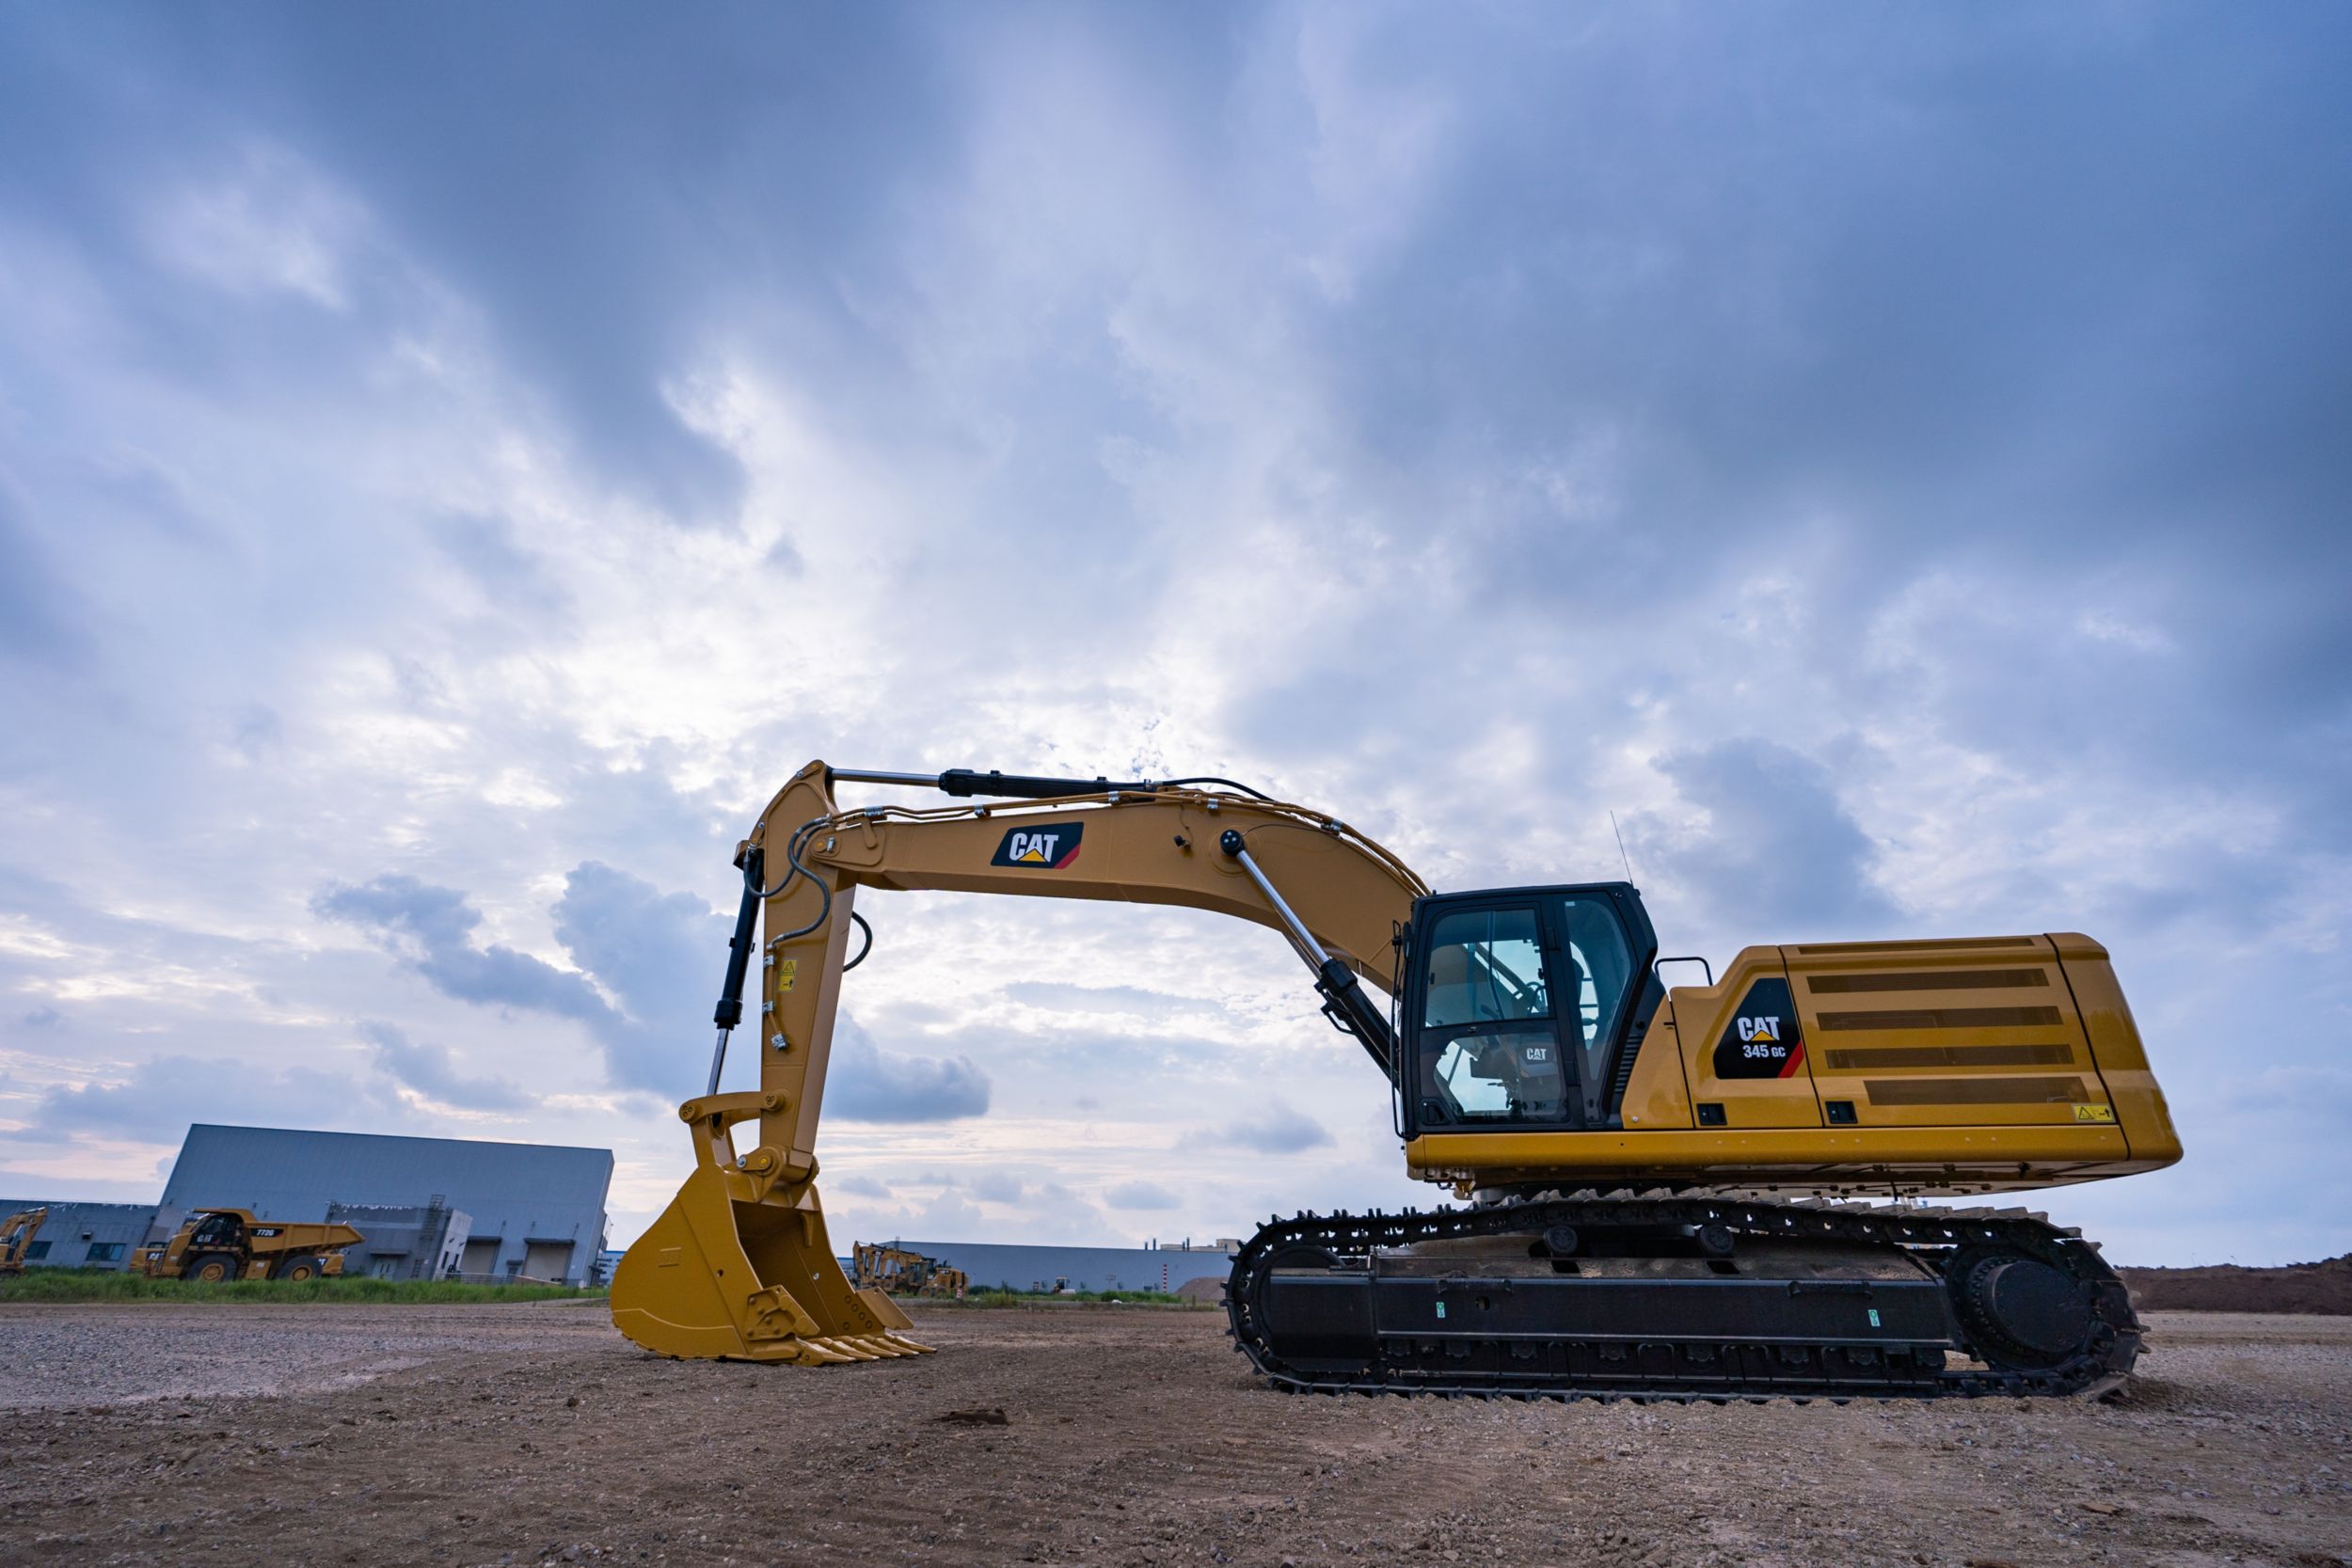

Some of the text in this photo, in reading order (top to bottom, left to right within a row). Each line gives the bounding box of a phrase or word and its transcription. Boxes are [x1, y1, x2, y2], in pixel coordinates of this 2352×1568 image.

[1009, 832, 1059, 863] CAT
[1737, 1016, 1780, 1041] CAT
[1526, 1048, 1548, 1061] CAT
[1742, 1044, 1787, 1058] 345 GC
